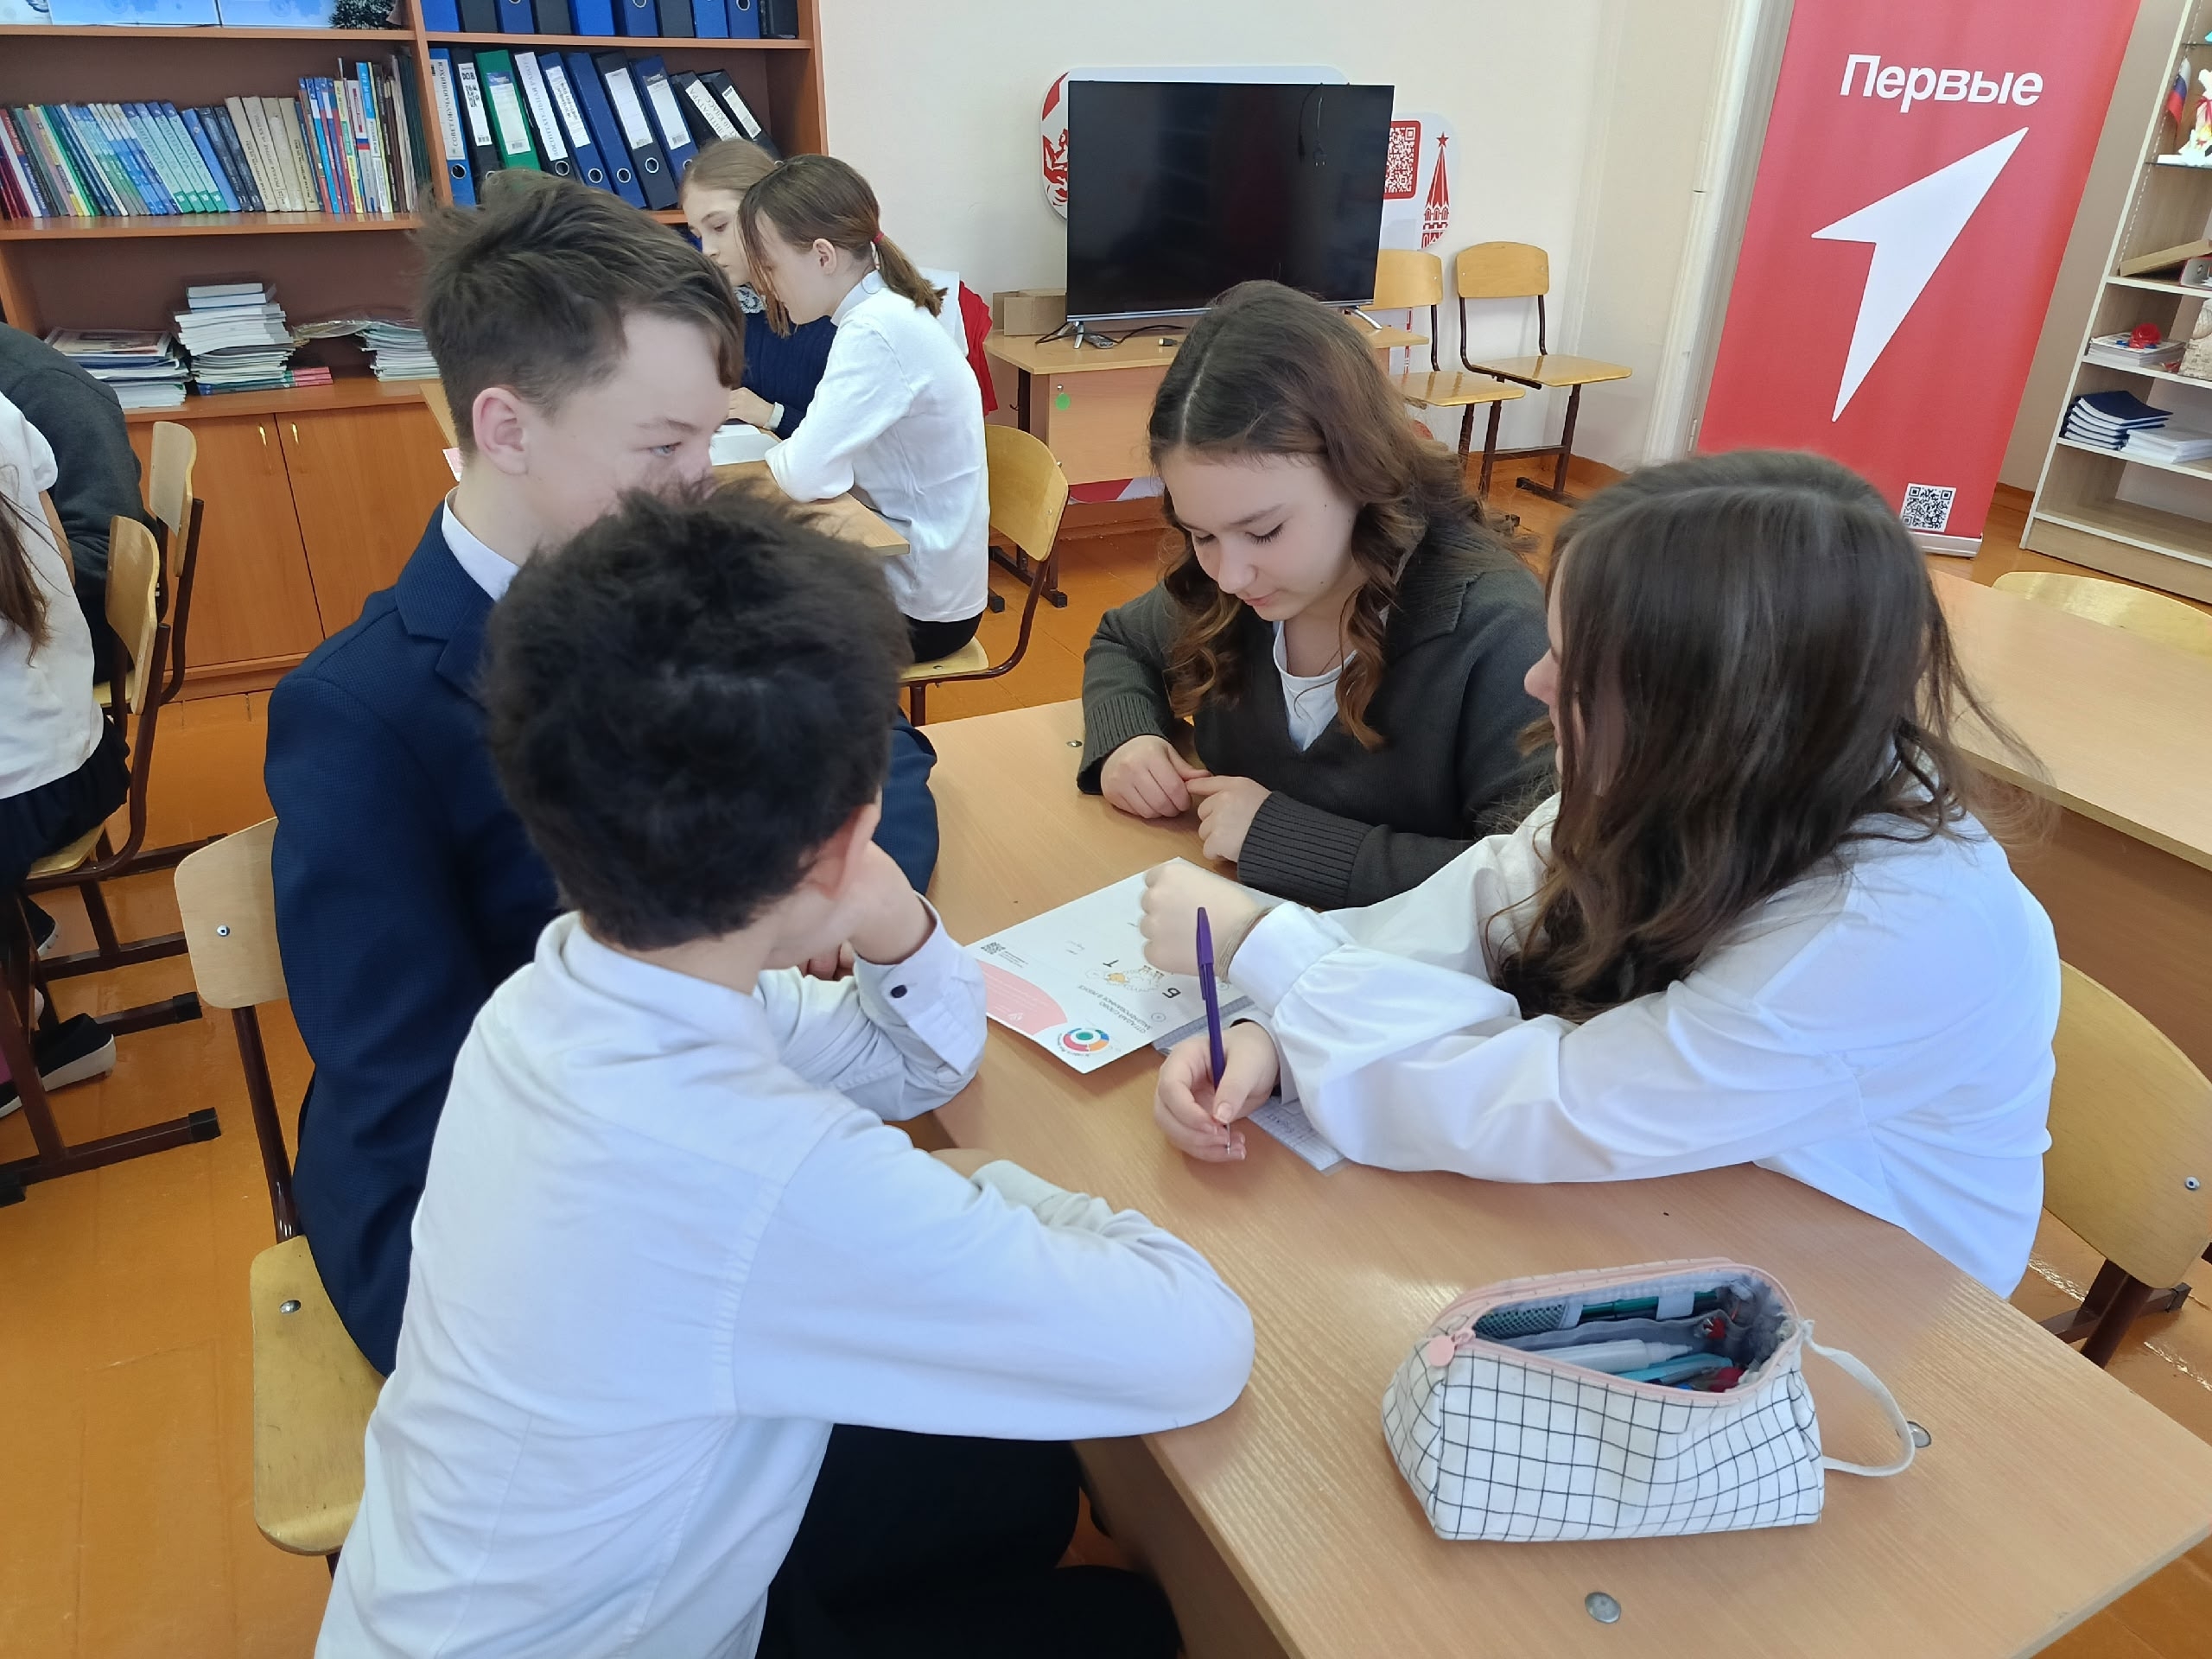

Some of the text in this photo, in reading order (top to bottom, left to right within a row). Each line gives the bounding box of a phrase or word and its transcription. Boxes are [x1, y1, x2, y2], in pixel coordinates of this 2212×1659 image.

[437, 61, 458, 147] СОВЕТ ОБУЧАЮЩИХСЯ
[1840, 54, 2044, 113] Первые
[531, 86, 560, 156] ВОСПИТАТЕЛЬНАЯ
[690, 88, 724, 136] ЛИТЕРАТУРА
[707, 99, 725, 122] КЛАСС
[139, 126, 164, 169] ЛИТЕРАТУРА
[164, 125, 189, 169] ЛИТЕРАТУРА
[177, 126, 203, 169] ЛИТЕРАТУРА
[1103, 959, 1119, 968] Т
[1162, 987, 1181, 999] Б
